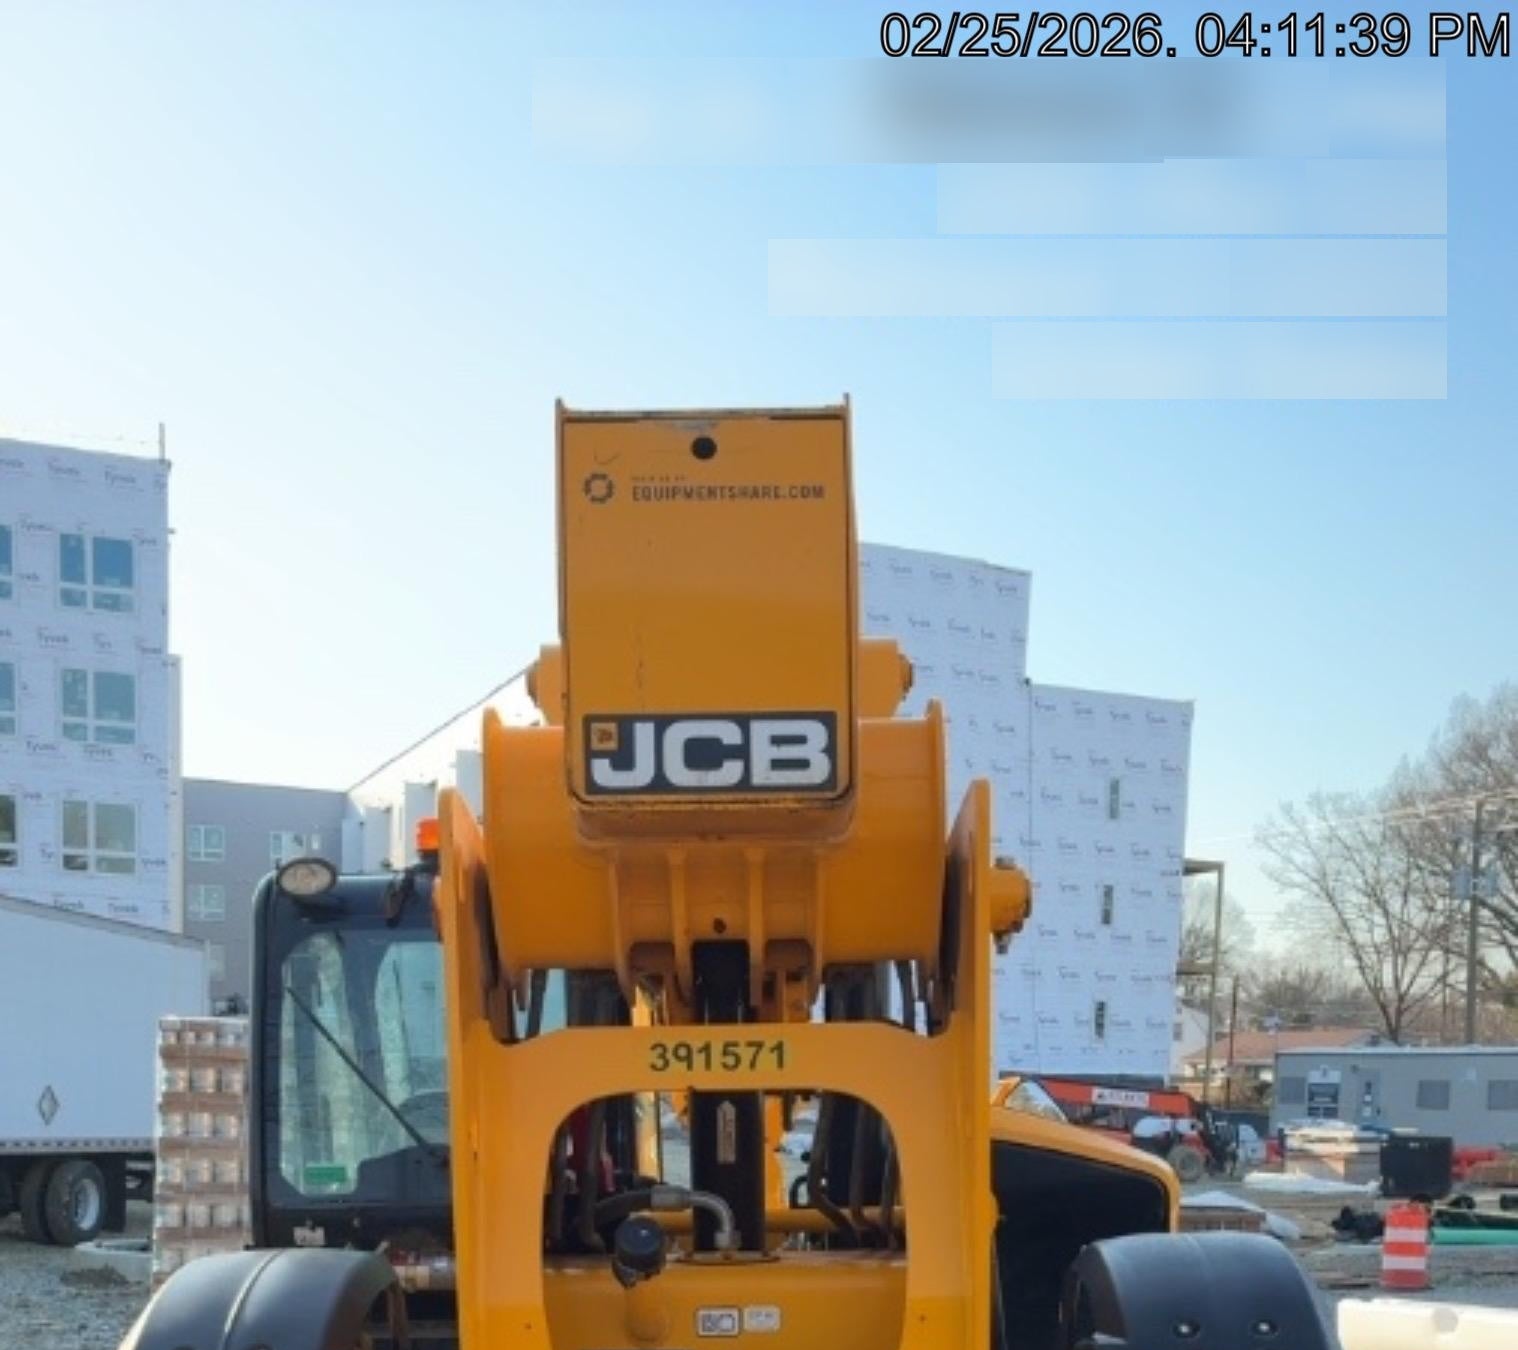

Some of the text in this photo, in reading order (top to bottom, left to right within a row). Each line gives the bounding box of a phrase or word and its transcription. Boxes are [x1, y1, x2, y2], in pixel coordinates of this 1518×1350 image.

[632, 485, 826, 501] EQUIPMENTSHARE.COM
[591, 719, 831, 788] JCB
[649, 1040, 785, 1072] 391571
